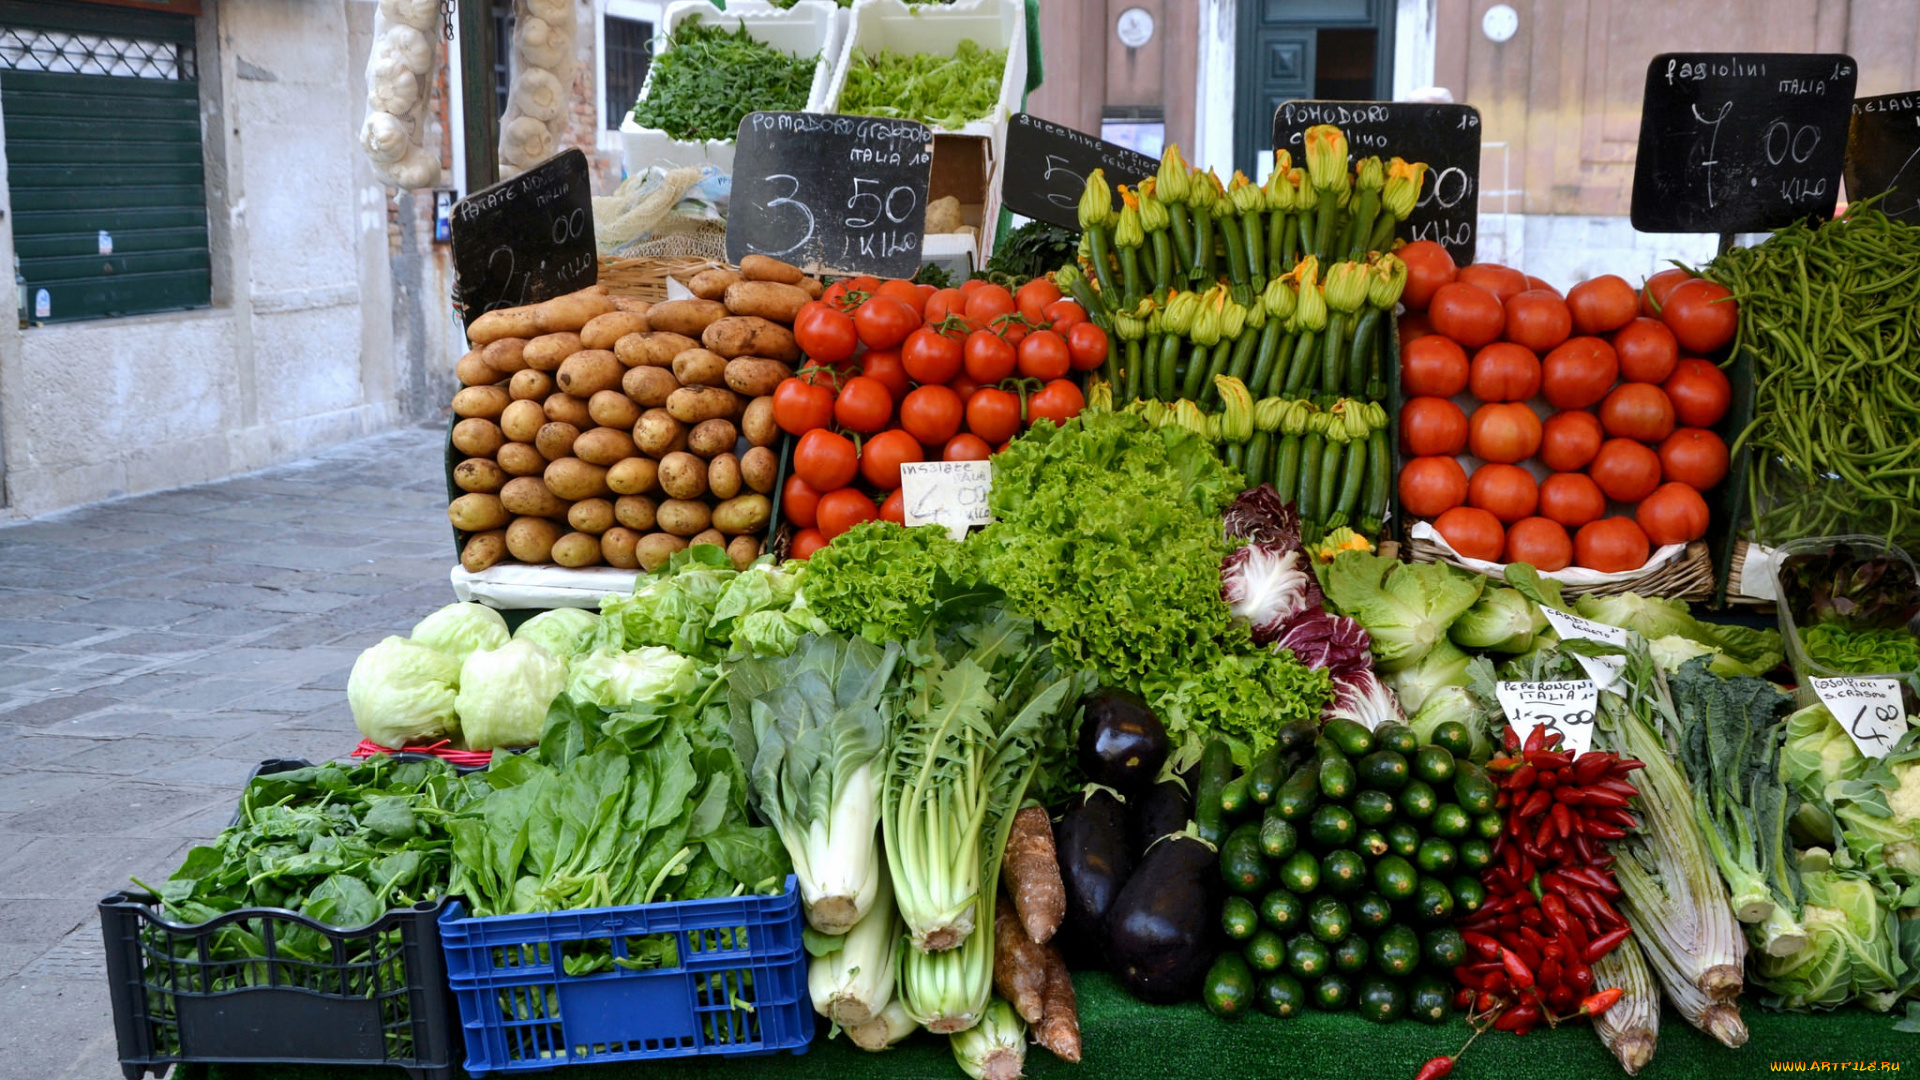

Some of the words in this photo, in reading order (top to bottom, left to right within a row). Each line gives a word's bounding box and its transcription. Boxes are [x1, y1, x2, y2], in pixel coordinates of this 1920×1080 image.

[1779, 79, 1826, 95] ITALIA
[1285, 105, 1389, 126] POMODORO
[850, 148, 901, 166] ITALIA
[1767, 122, 1821, 165] 00
[1044, 155, 1088, 209] 5
[1780, 178, 1826, 204] KILO
[461, 187, 516, 221] PATATE
[747, 173, 815, 256] 3
[845, 177, 916, 228] 50
[553, 208, 585, 244] 00
[1411, 219, 1471, 248] KILO
[860, 230, 917, 258] KILO
[558, 252, 591, 281] KILO
[1504, 681, 1593, 691] PEPERONCINI
[1519, 690, 1575, 701] ITALIA
[1852, 705, 1889, 745] 4
